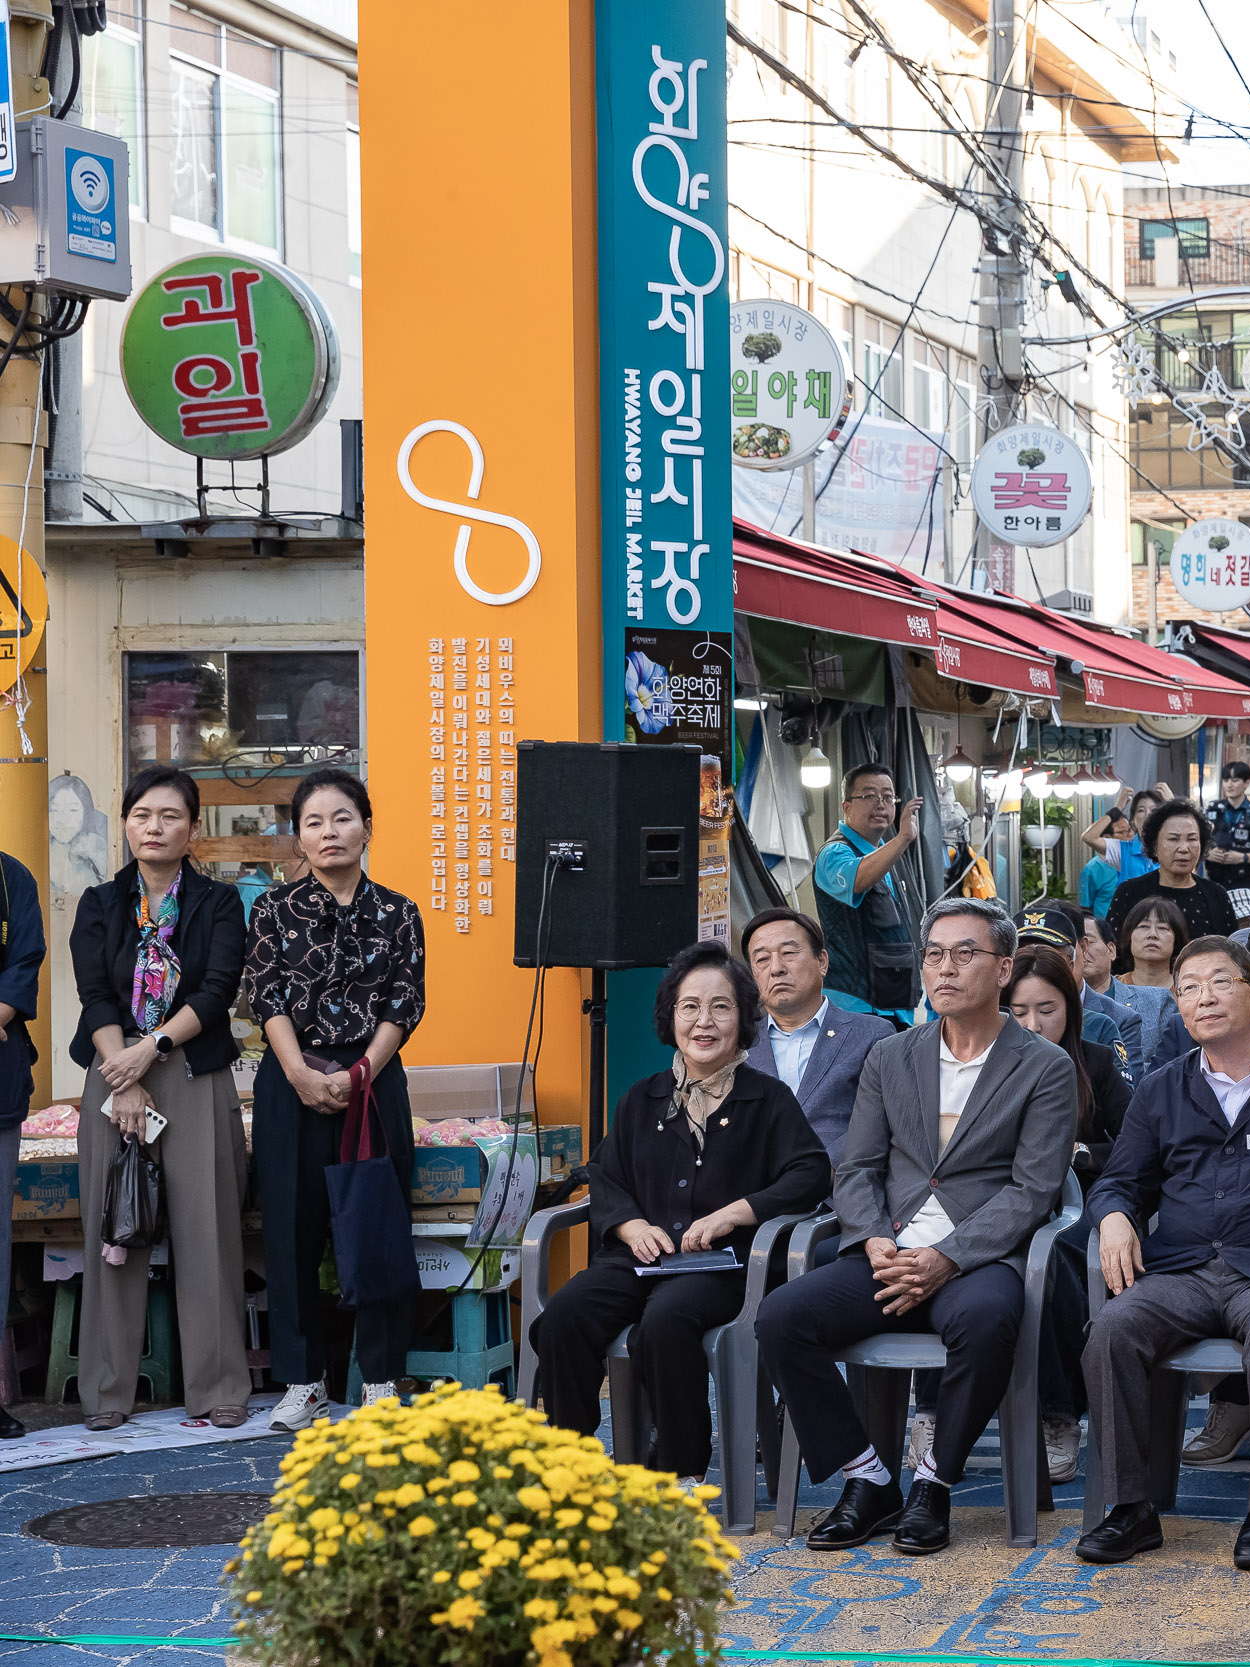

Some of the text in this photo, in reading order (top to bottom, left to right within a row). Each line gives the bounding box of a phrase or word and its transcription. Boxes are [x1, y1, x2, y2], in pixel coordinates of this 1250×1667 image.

[161, 267, 271, 439] 과일
[632, 45, 725, 625] 화양제일시장
[624, 368, 642, 482] HWAYANG
[625, 488, 643, 527] JEIL
[1004, 516, 1061, 531] 한아름
[626, 534, 644, 620] MARKET
[452, 637, 468, 690] 발전을
[475, 637, 491, 724] 기성세대와
[652, 675, 722, 701] 화양연화
[652, 703, 721, 728] 맥주축제
[499, 730, 515, 765] 띠는
[428, 638, 447, 911] 화양제일시장의 심볼과 로고입니다
[500, 770, 515, 821] 전통과
[454, 806, 470, 859] 컨셉을
[477, 824, 493, 876] 조화를
[500, 827, 515, 861] 현대
[454, 863, 470, 933] 형상화한
[478, 881, 493, 915] 이뤄
